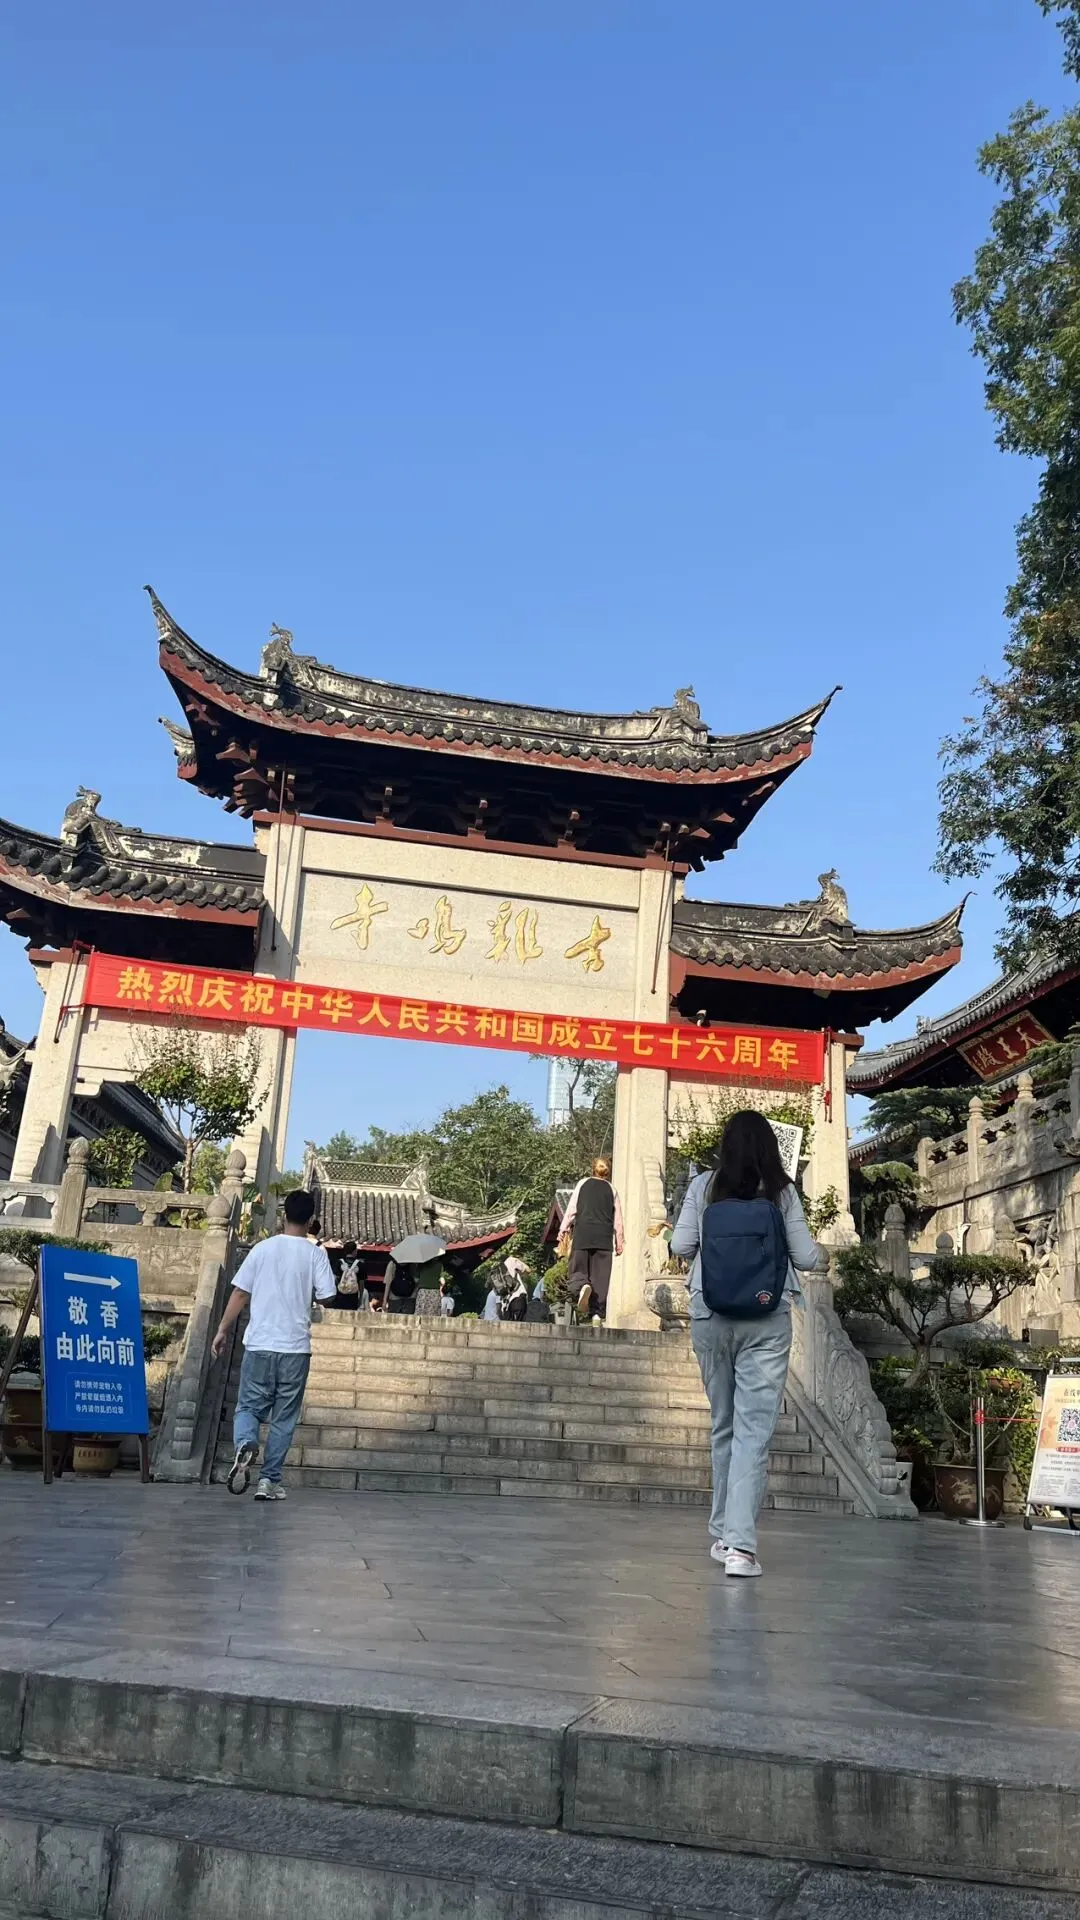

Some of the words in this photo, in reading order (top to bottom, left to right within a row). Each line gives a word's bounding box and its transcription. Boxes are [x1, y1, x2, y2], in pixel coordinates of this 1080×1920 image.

[116, 966, 800, 1071] 热烈庆祝中华人民共和国成立七十六周年
[67, 1296, 119, 1329] 敬香
[56, 1331, 135, 1367] 由此向前
